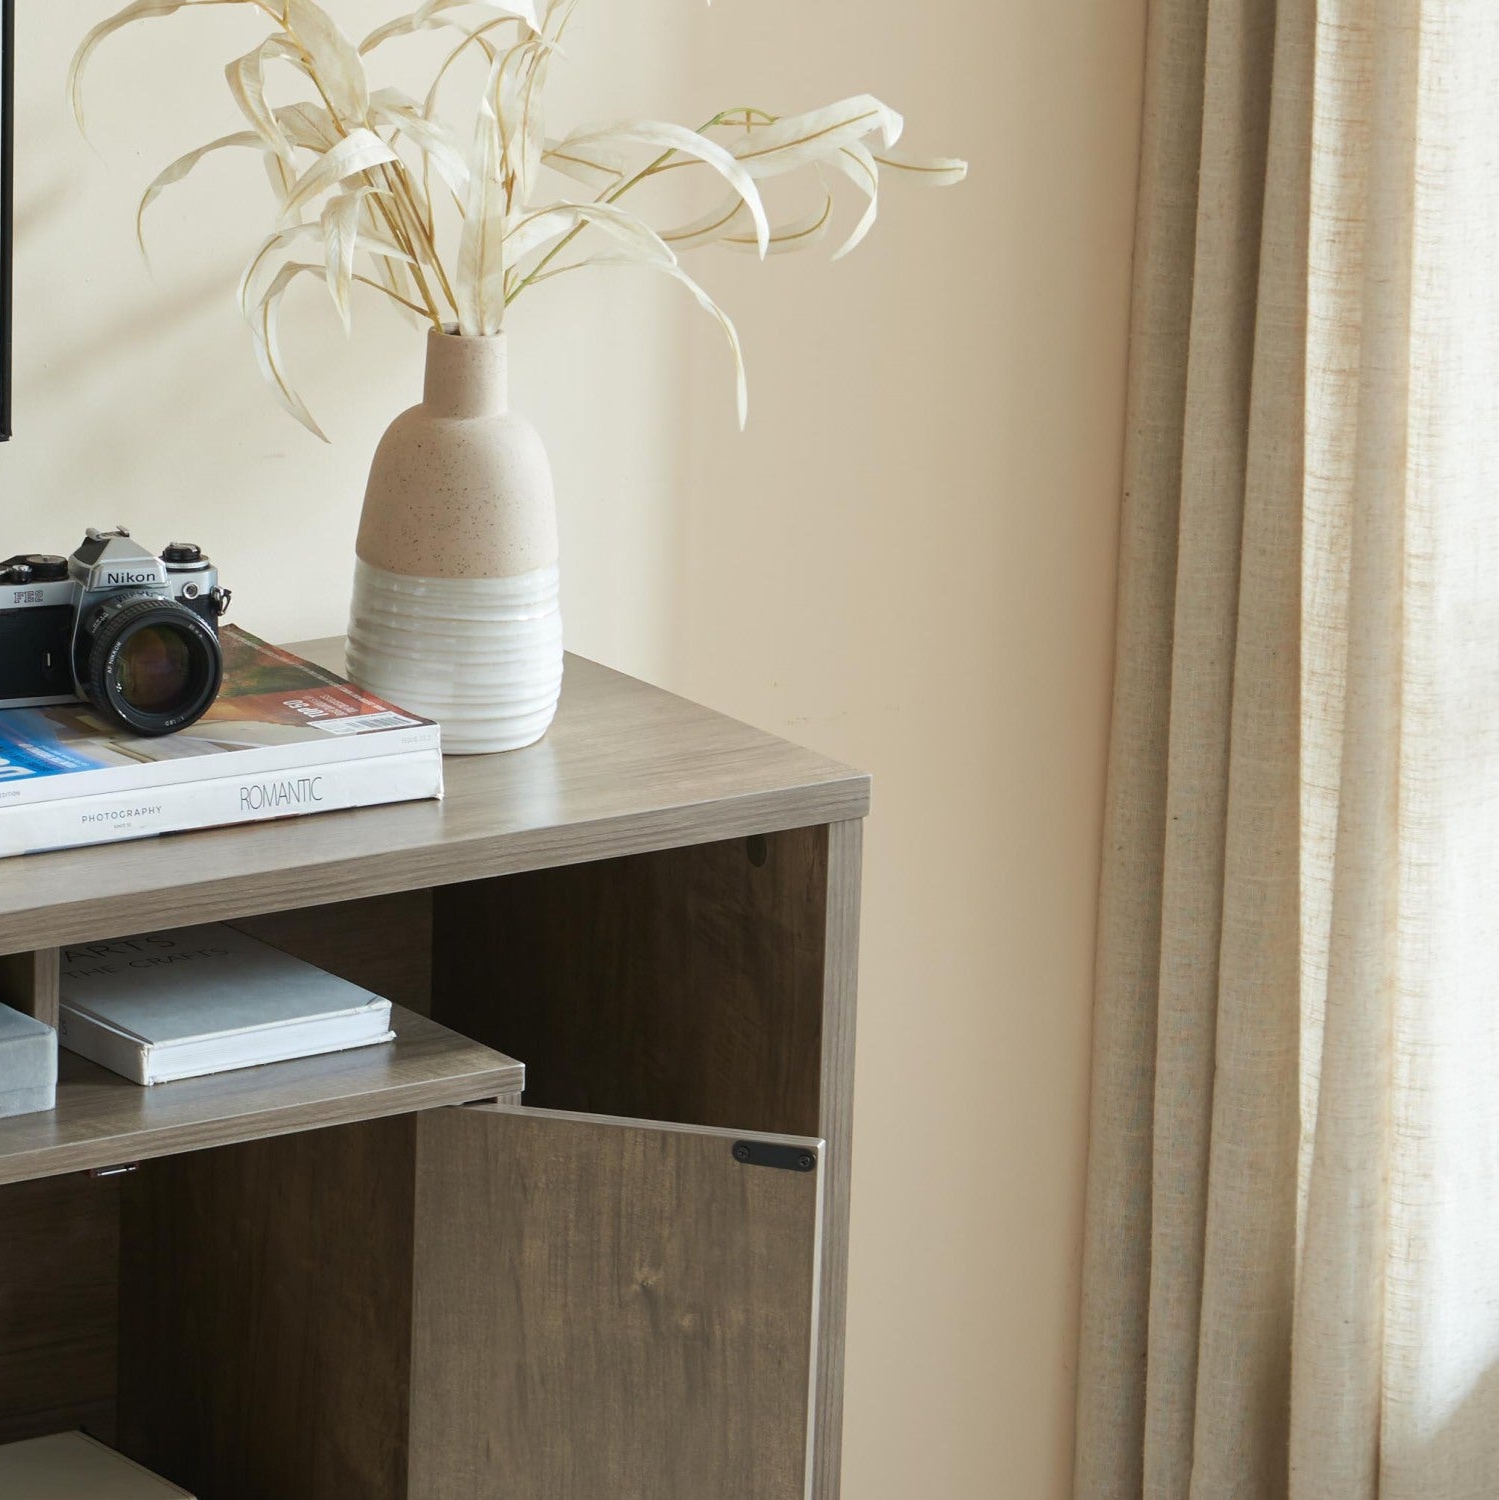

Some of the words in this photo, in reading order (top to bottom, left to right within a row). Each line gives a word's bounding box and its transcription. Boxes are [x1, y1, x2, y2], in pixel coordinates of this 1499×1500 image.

[107, 571, 156, 584] Nikon
[13, 589, 44, 604] FE2
[240, 776, 323, 811] ROMANTIC
[81, 806, 163, 824] PHOTOGRAPHY
[64, 935, 176, 963] ARTS
[129, 947, 229, 968] CRAFTS
